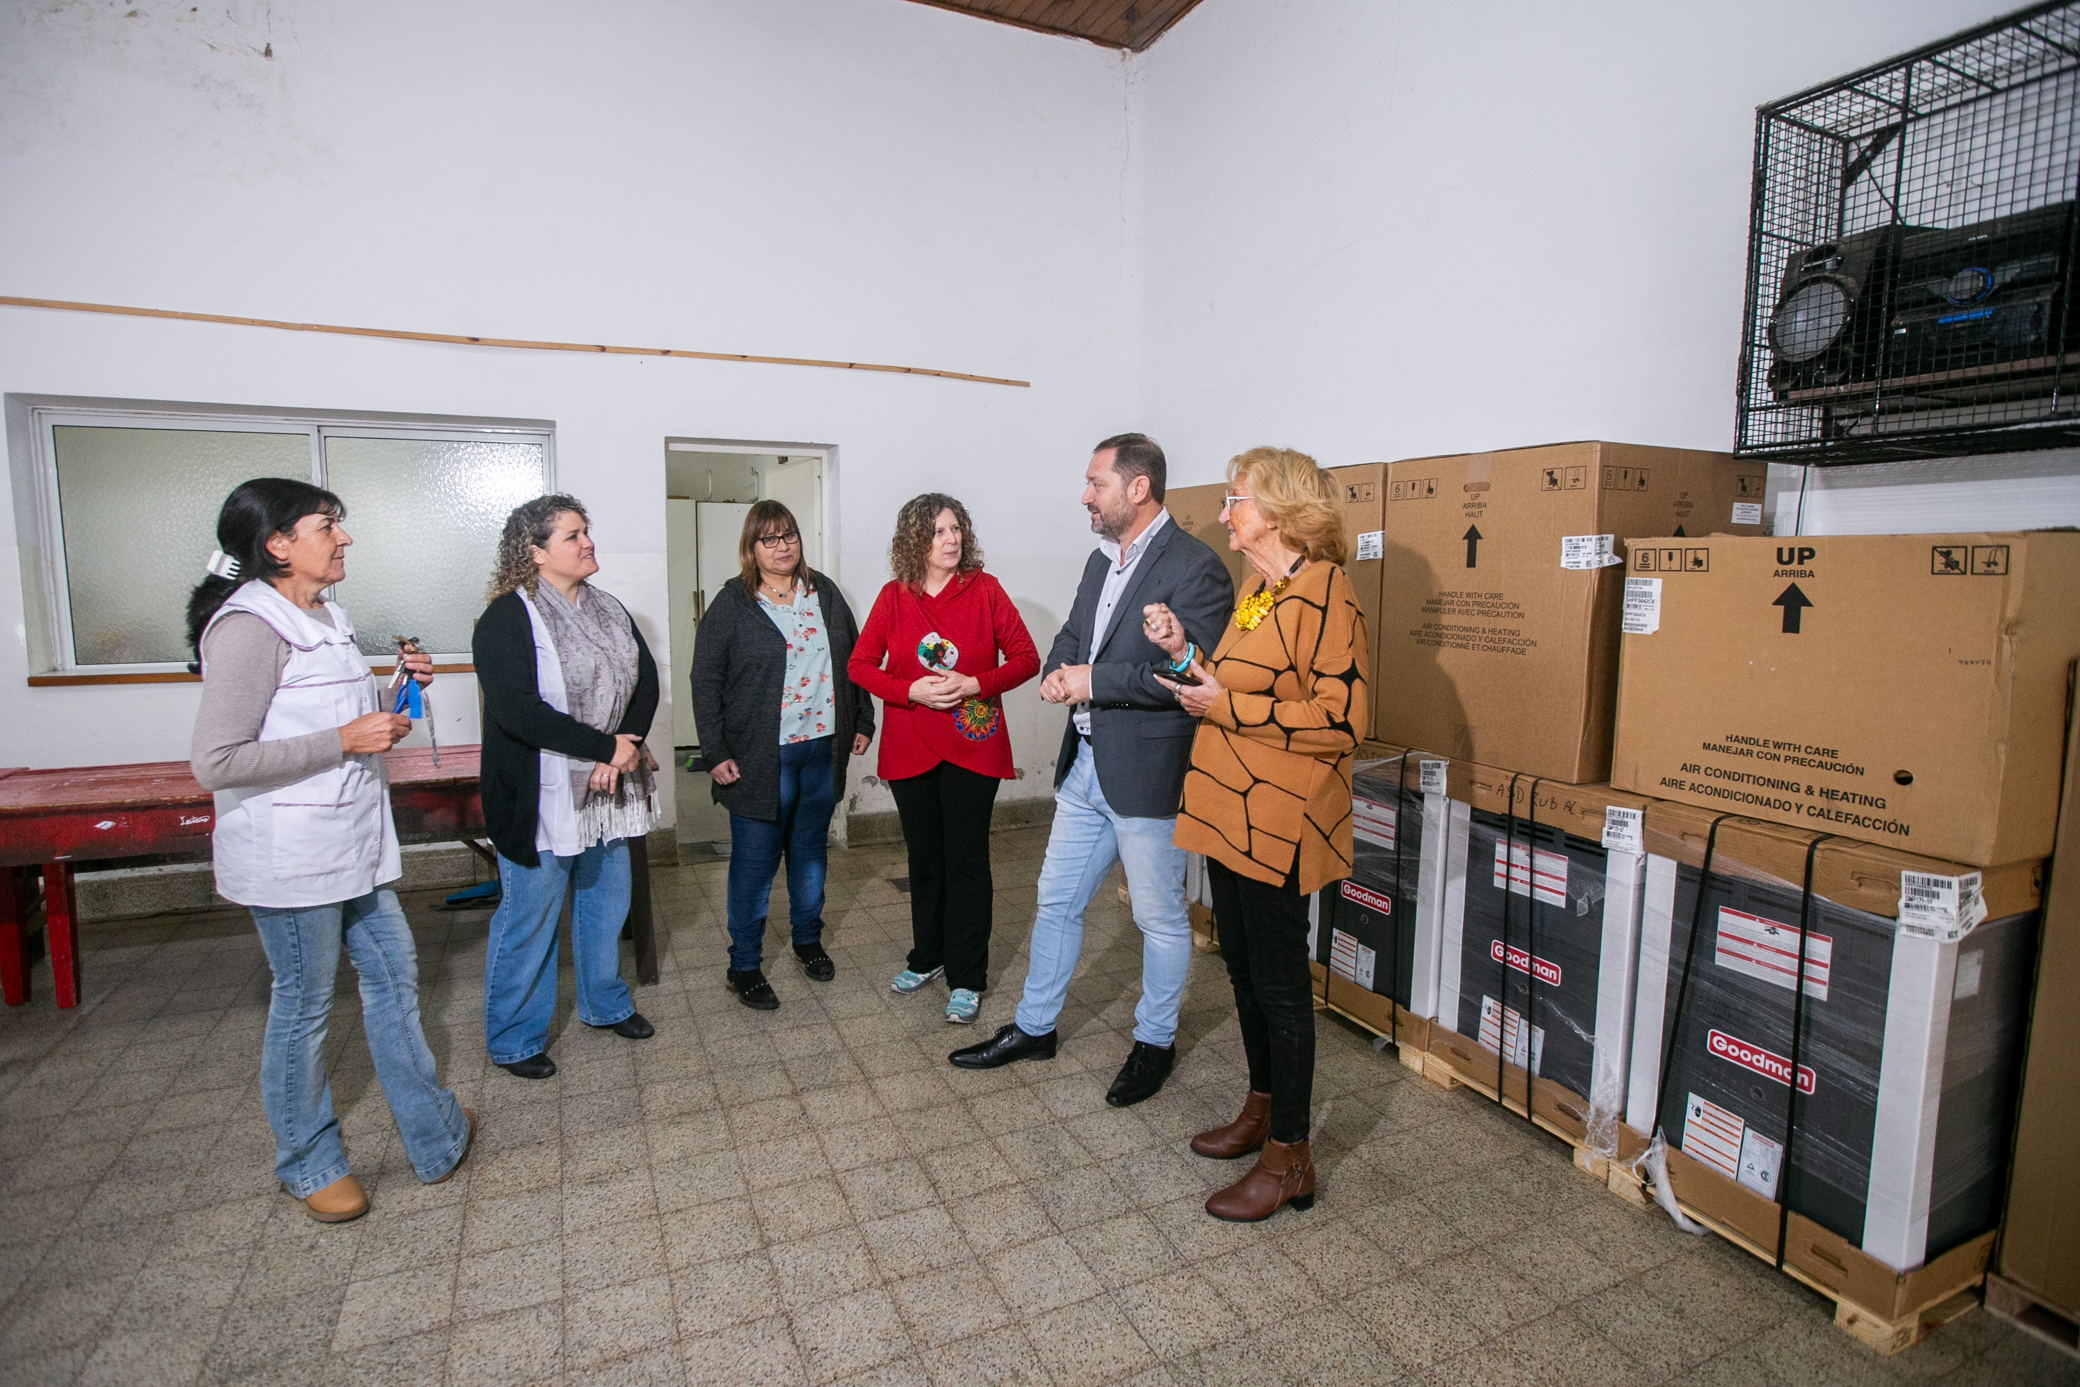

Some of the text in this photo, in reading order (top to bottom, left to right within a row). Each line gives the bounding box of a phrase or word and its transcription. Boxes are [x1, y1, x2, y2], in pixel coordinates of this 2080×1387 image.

[1465, 510, 1483, 518] HAUT
[1641, 552, 1650, 563] 6
[1776, 547, 1816, 566] UP
[1773, 569, 1815, 578] ARRIBA
[1425, 598, 1455, 607] MANEJAR
[1471, 600, 1520, 610] PRECAUCIÓN
[1438, 591, 1464, 599] HANDLE
[1484, 592, 1504, 600] CARE
[1421, 606, 1525, 619] MANIPULER AVEC PRÉCAUTION
[1409, 629, 1423, 637] AIRE
[1423, 631, 1477, 642] ACONDICIONADO
[1484, 636, 1538, 647] CALEFACCIÓN
[1422, 622, 1432, 630] AIR
[1433, 623, 1480, 634] CONDITIONING
[1488, 627, 1521, 637] HEATING
[1415, 638, 1527, 655] AIR CONDITIONNÉ ET CHAUFFAGE
[1725, 734, 1839, 759] HANDLE WITH CARE
[1702, 742, 1865, 776] MANEJAR CON PRECAUCIÓN
[1680, 762, 1887, 810] AIR CONDITIONING & HEATING
[1659, 777, 1911, 837] AIRE ACONDICIONADO Y CALEFACCIÓN
[1343, 884, 1389, 910] Goodman
[1712, 1035, 1810, 1088] Goodman
